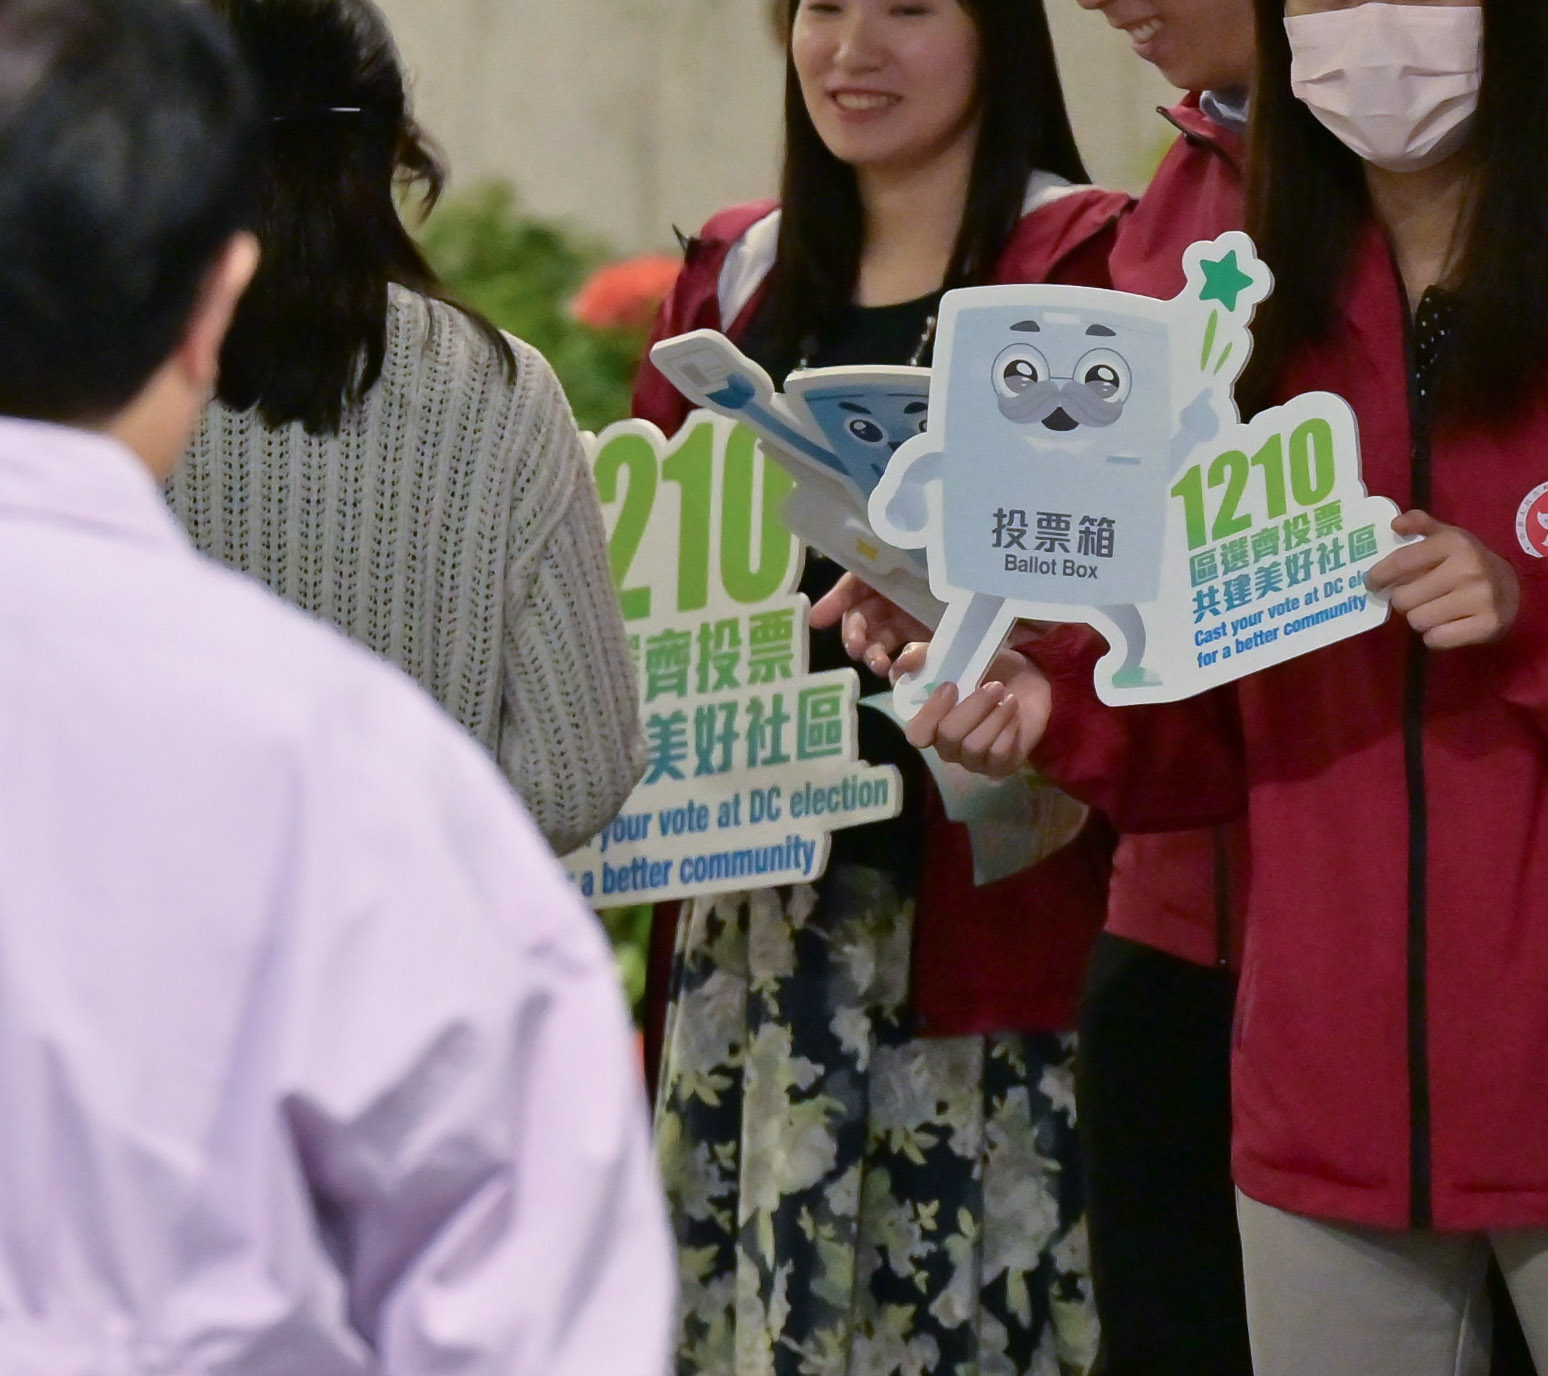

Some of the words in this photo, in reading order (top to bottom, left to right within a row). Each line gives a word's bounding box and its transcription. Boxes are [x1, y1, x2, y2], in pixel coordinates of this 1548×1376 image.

[1170, 418, 1336, 552] 1210
[991, 507, 1116, 559] 投票箱
[1005, 554, 1057, 575] Ballot
[1062, 559, 1099, 580] Box
[1188, 498, 1344, 588] 區選齊投票
[1192, 523, 1379, 625] 共建美好社區
[1194, 621, 1228, 647] Cast
[1230, 610, 1265, 637] your
[1267, 597, 1301, 620] vote
[1304, 586, 1320, 607] at
[1323, 577, 1345, 599] DC
[1196, 648, 1220, 669] for
[1221, 644, 1233, 660] a
[1235, 626, 1281, 655] better
[1282, 592, 1368, 637] community
[658, 799, 710, 837] vote
[717, 791, 742, 829] at
[749, 783, 782, 825] DC
[789, 773, 889, 820] election
[581, 870, 595, 898] a
[601, 856, 674, 896] better
[679, 834, 817, 885] community
